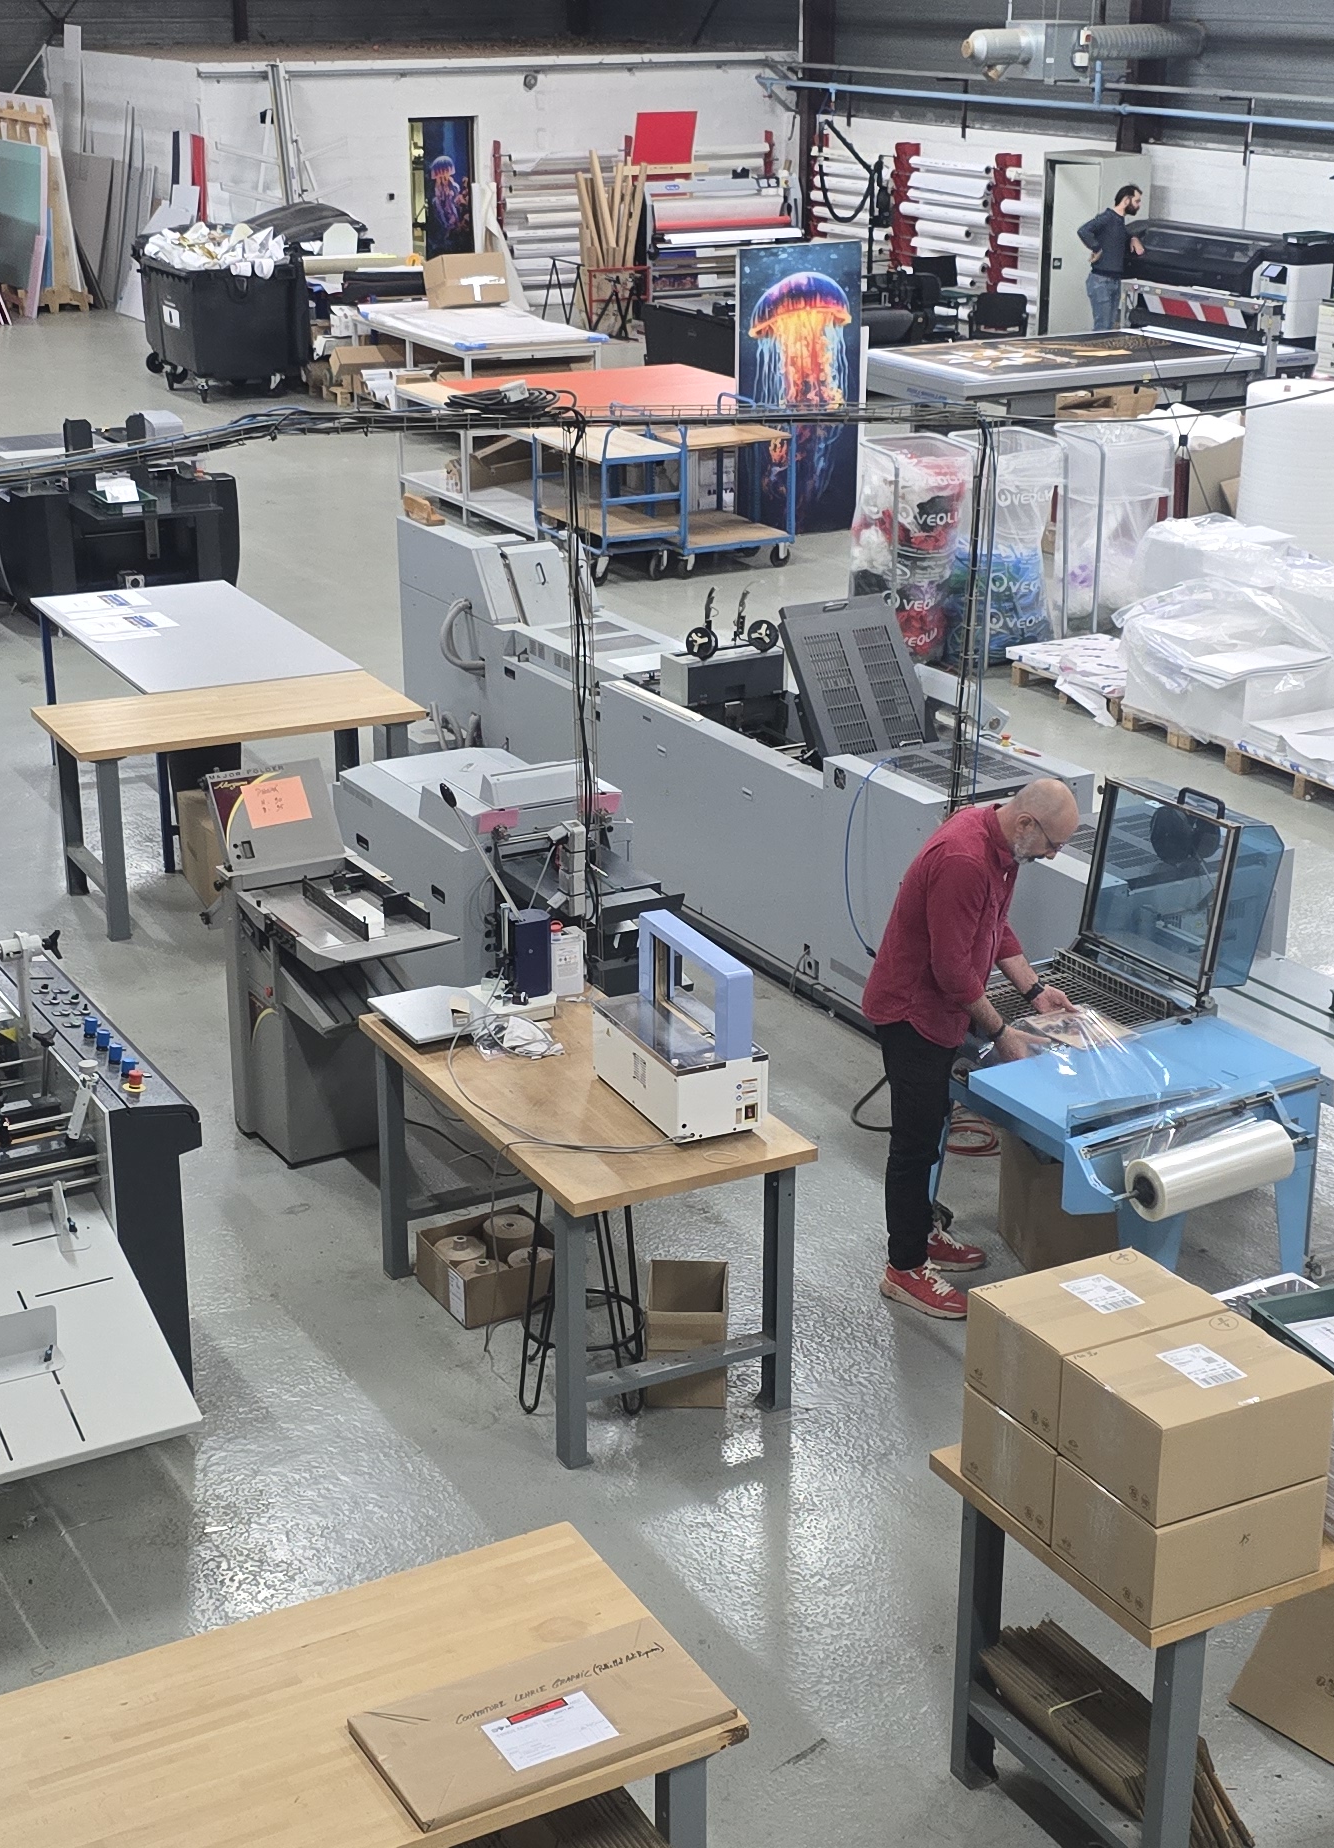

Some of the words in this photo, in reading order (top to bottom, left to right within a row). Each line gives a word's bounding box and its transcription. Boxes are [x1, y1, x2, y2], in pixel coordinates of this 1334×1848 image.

[916, 511, 960, 527] VEOLI
[208, 771, 242, 781] MAJOR
[246, 764, 285, 775] FOLDER
